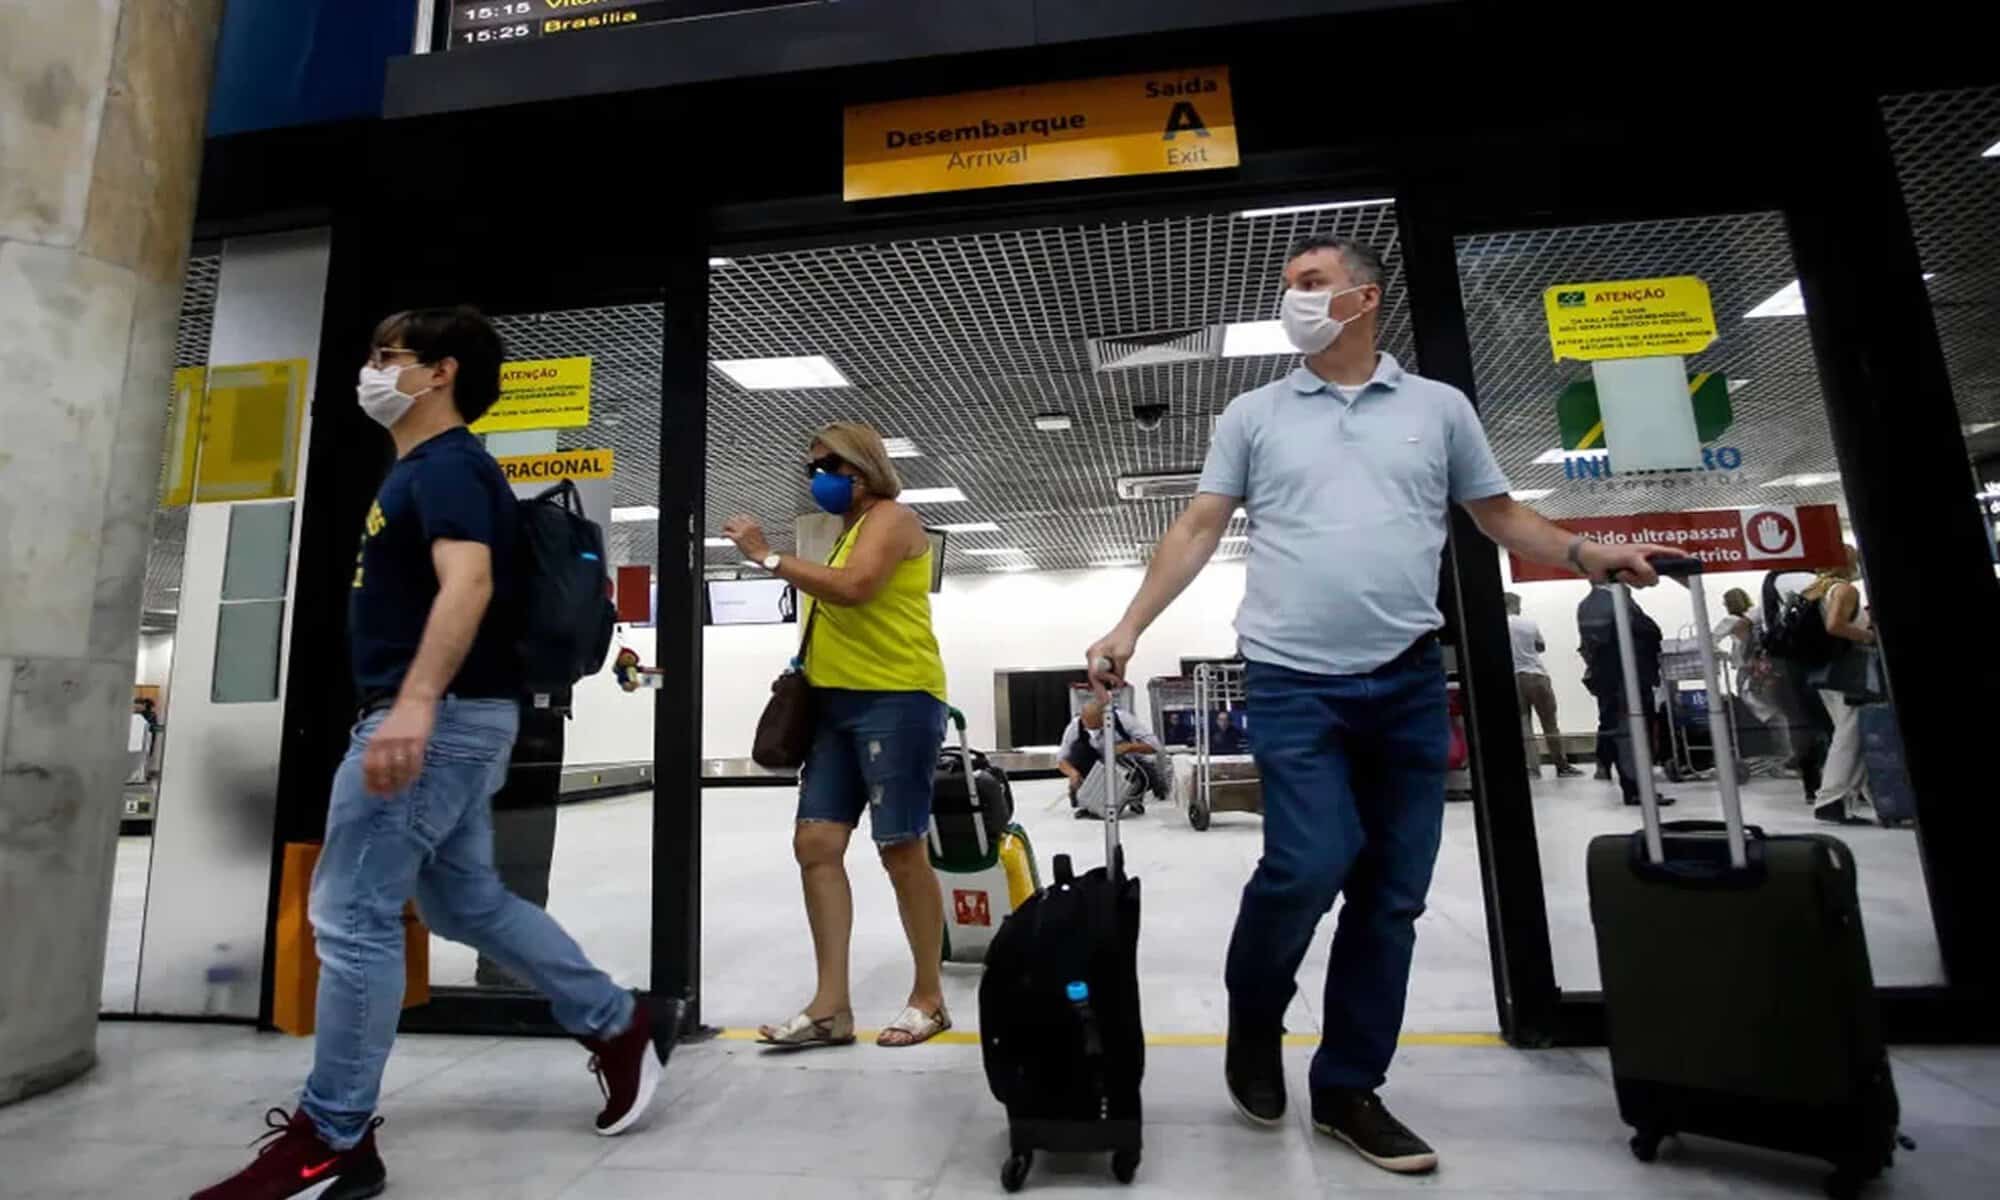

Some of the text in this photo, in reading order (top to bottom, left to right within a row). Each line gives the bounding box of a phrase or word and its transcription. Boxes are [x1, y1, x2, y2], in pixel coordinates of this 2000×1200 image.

[465, 2, 531, 20] 15:15
[463, 11, 637, 44] 15:25 Brasília
[1145, 76, 1218, 98] Saída
[886, 111, 1086, 149] Desembarque
[1162, 101, 1210, 140] A
[946, 144, 1028, 171] Arrival
[1167, 145, 1209, 166] Exit
[1594, 288, 1665, 303] ATENÇÃO
[501, 457, 604, 480] RACIONAL
[1632, 527, 1737, 544] ultrapassar
